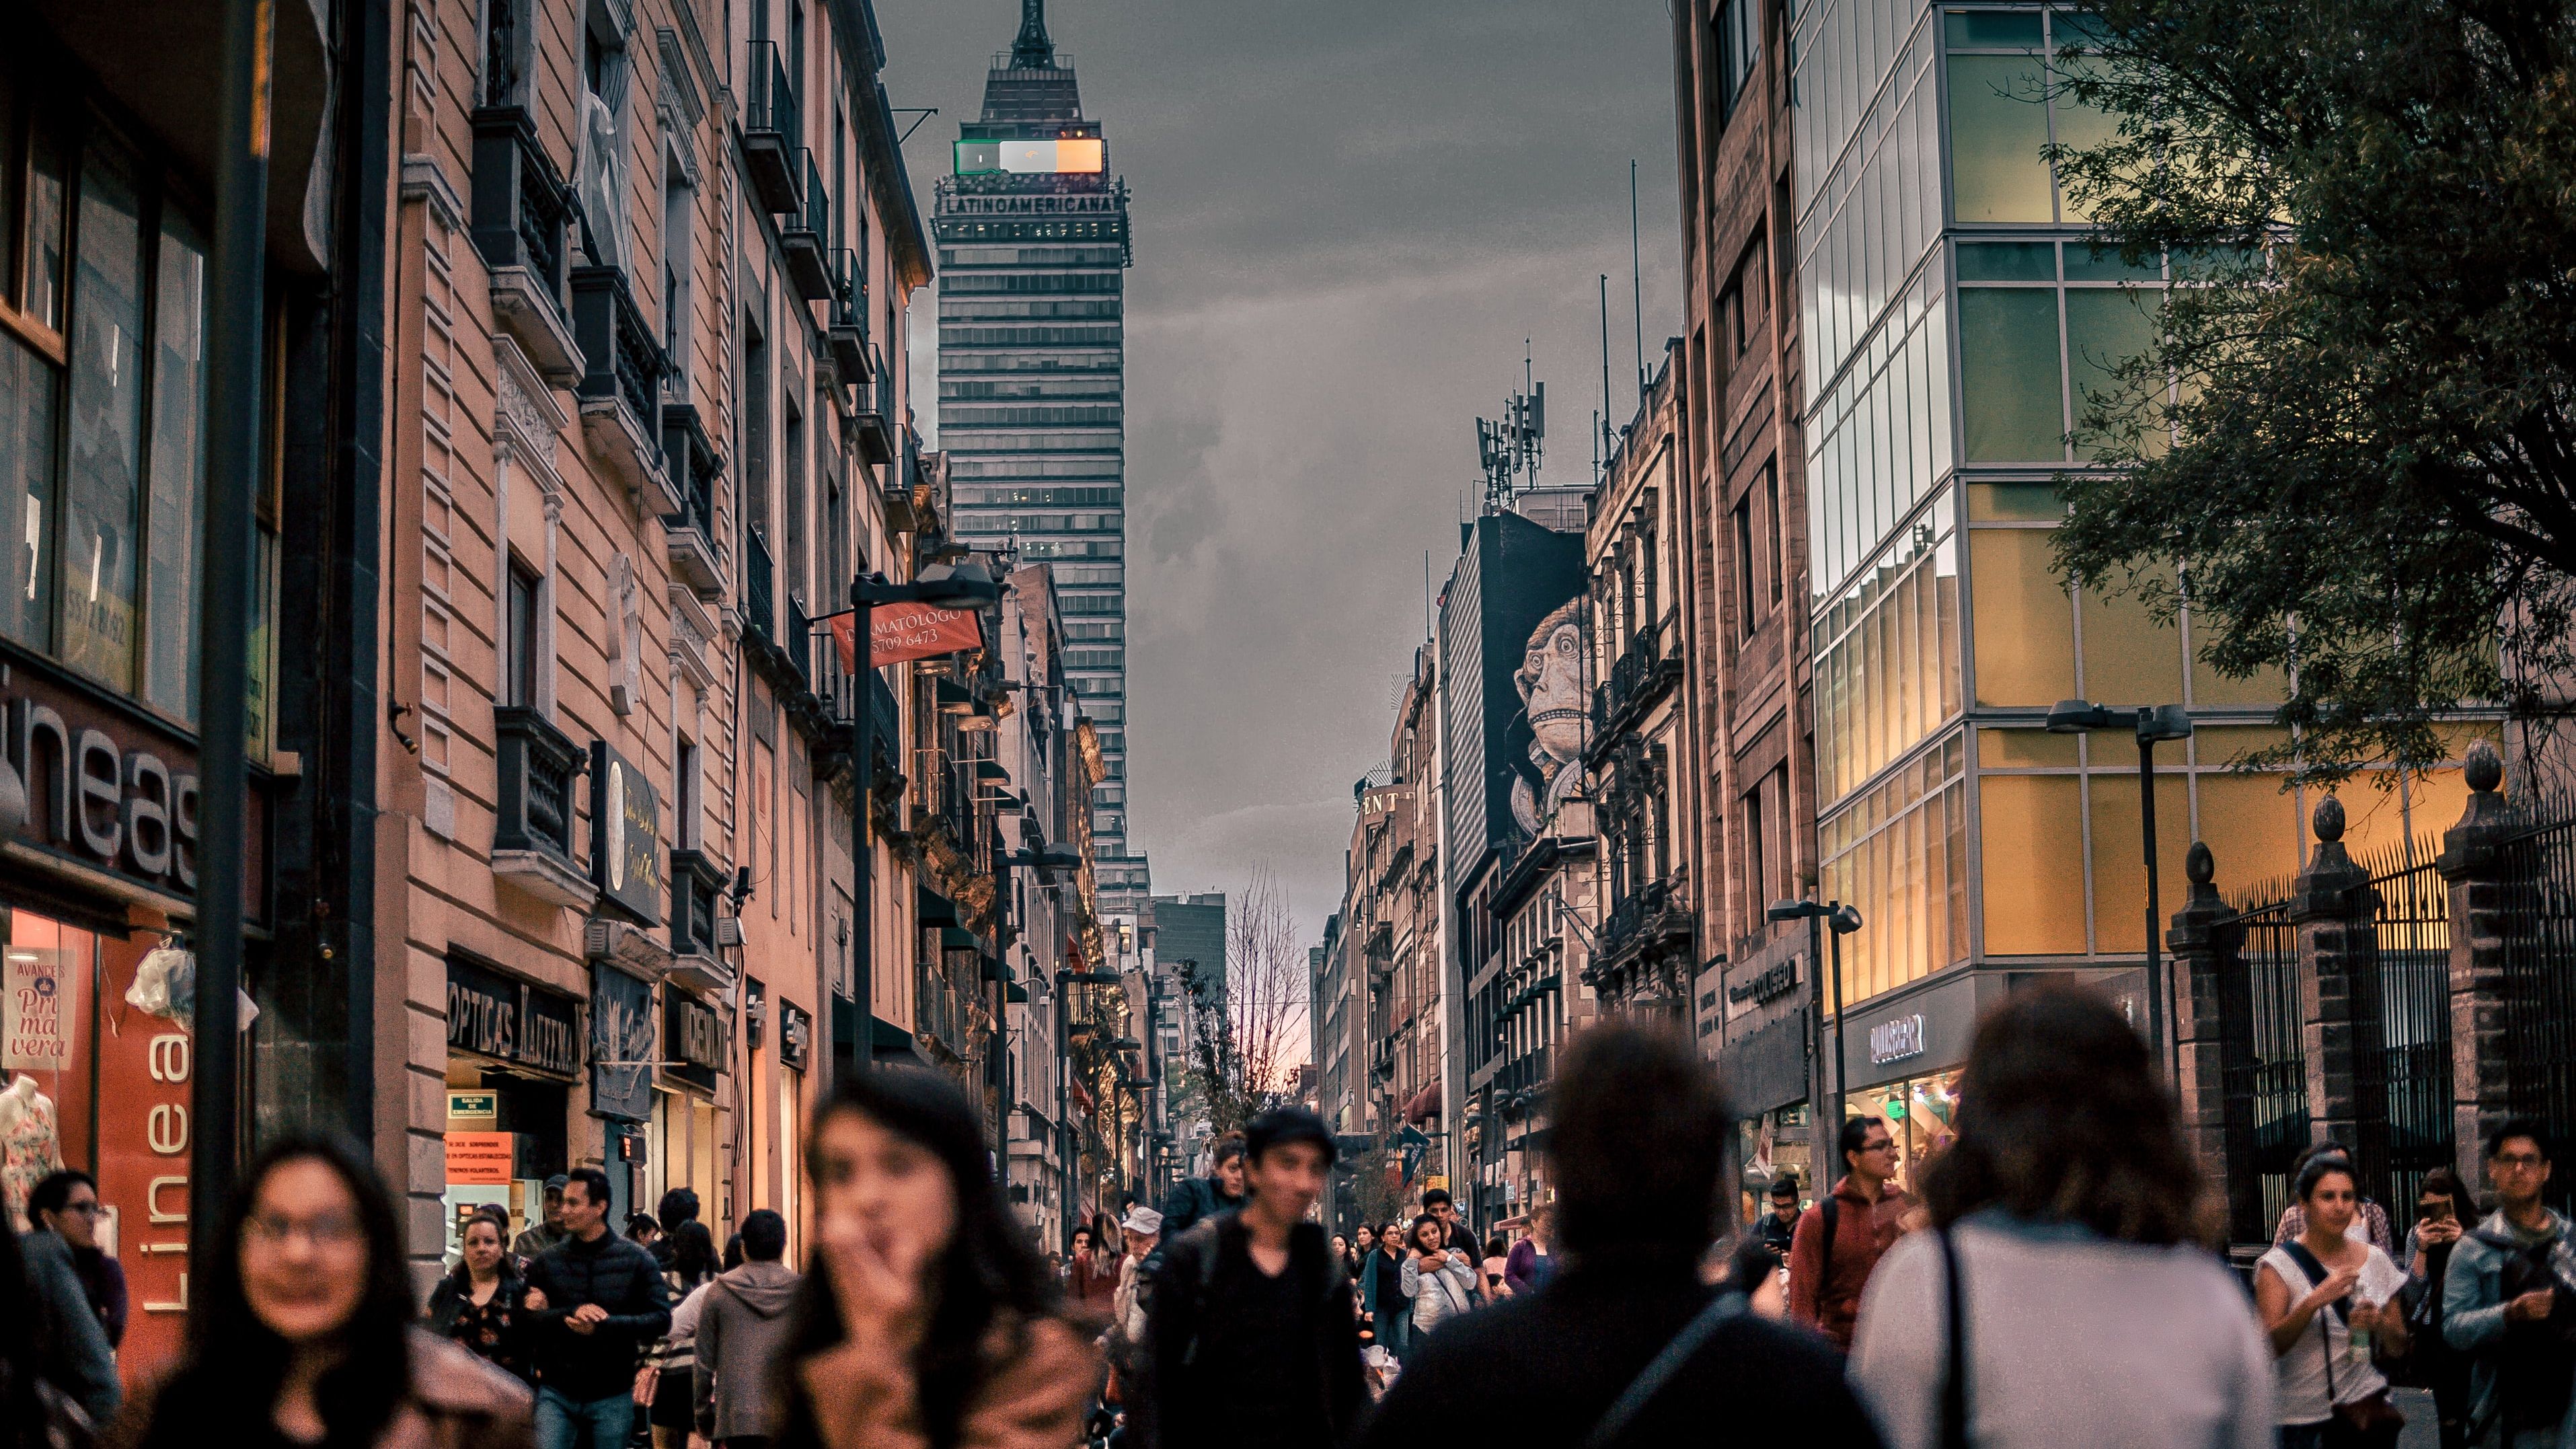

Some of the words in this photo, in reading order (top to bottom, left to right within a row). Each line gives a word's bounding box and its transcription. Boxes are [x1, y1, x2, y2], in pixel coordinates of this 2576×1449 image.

[946, 197, 1112, 213] LATINOAMERICANA
[845, 609, 961, 642] DMATÓLOGO
[871, 636, 901, 654] 5709
[906, 628, 938, 647] 6473
[17, 963, 65, 978] AVANCES
[11, 1038, 65, 1057] vera
